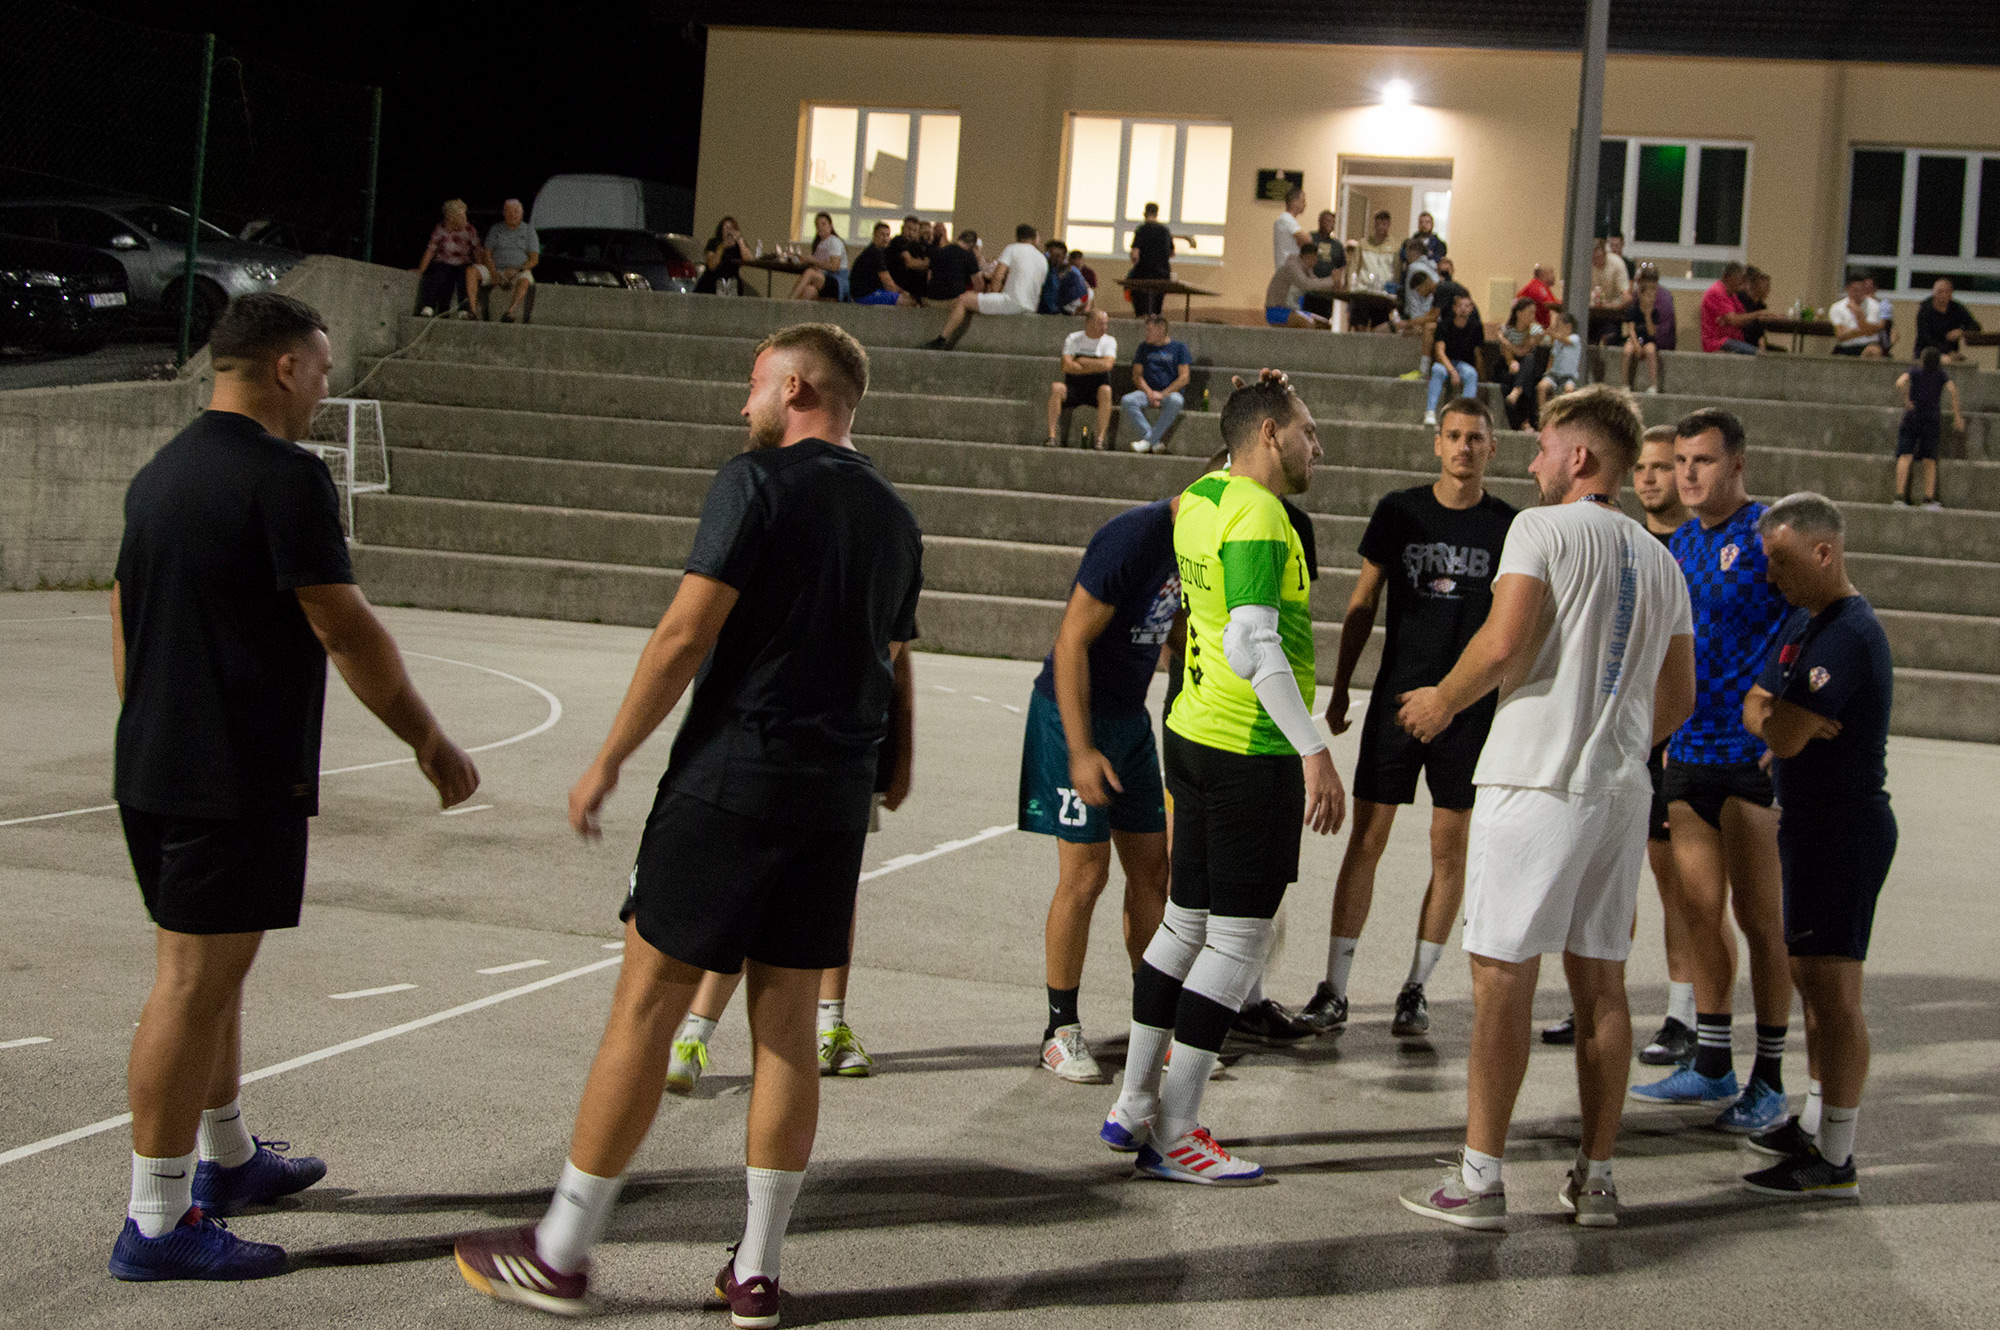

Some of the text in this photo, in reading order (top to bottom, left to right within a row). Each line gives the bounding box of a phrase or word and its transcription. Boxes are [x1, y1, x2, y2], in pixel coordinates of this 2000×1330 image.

[1601, 567, 1638, 696] UNIVERSITY OF SPLIT
[1056, 787, 1087, 827] 23
